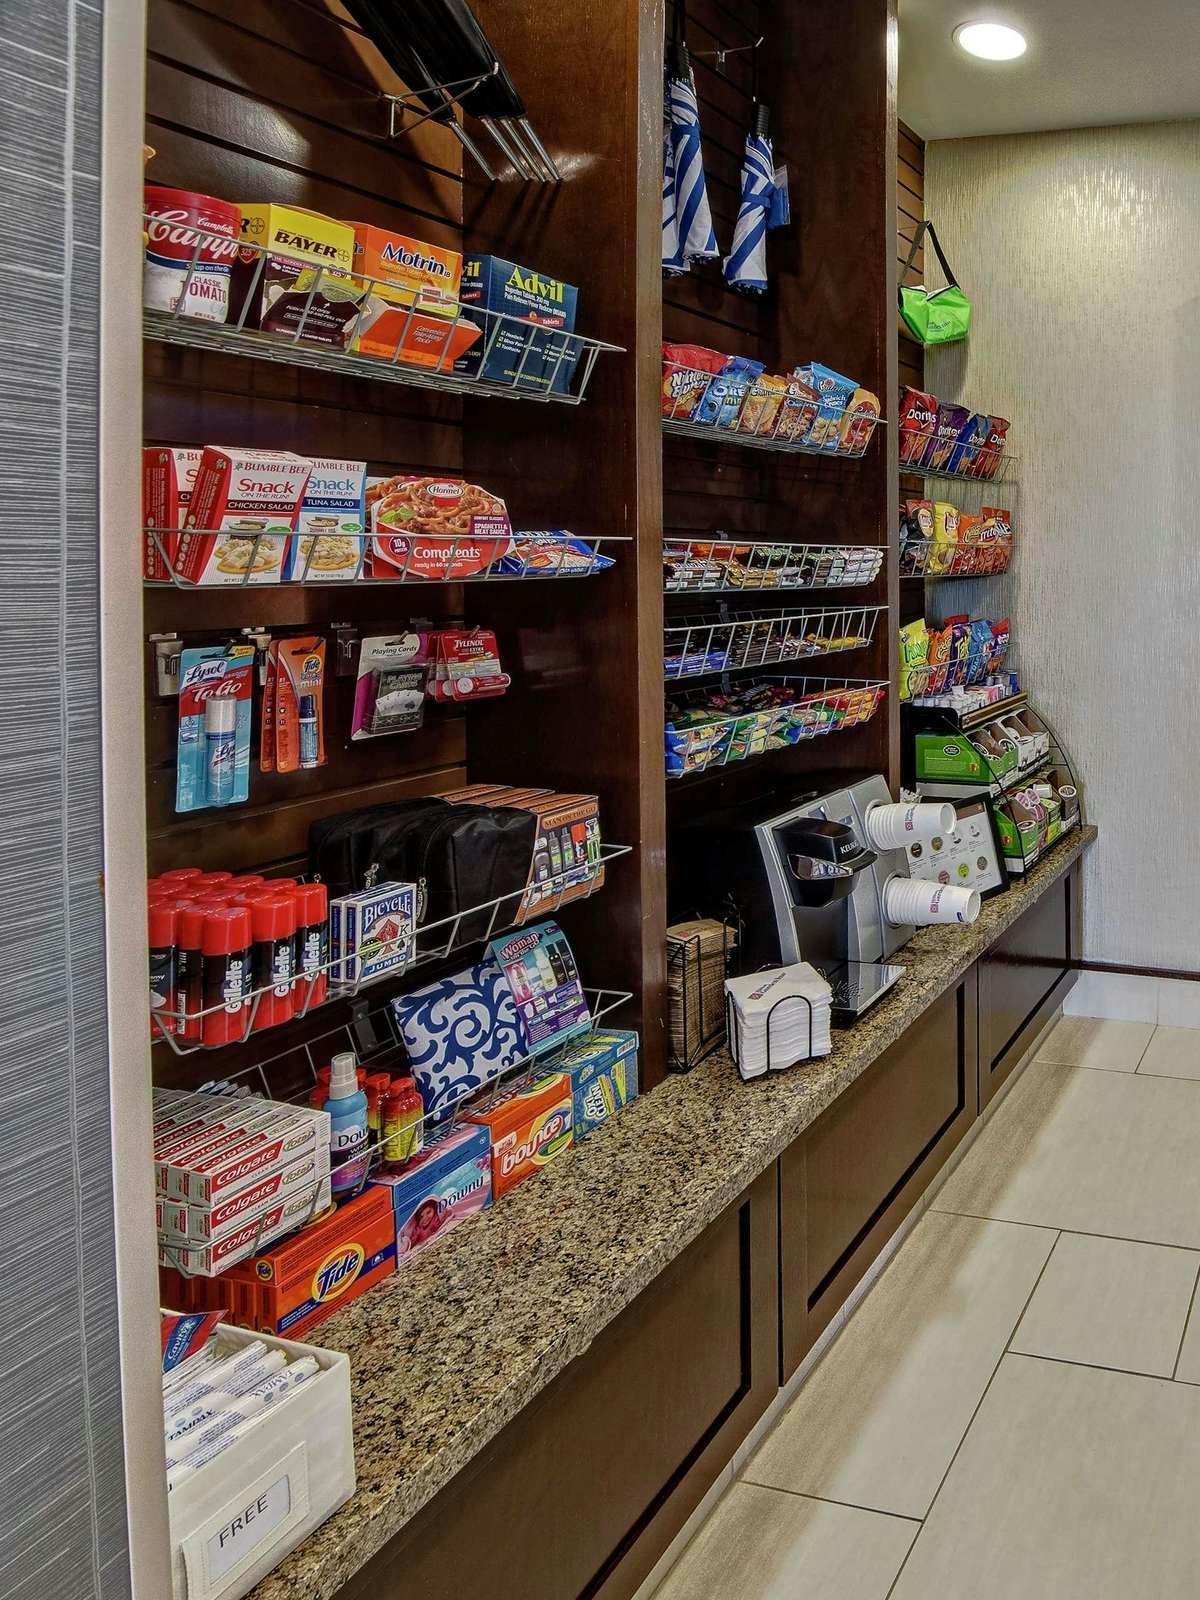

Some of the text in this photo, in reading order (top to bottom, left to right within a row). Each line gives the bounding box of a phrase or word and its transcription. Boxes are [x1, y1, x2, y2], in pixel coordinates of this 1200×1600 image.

[274, 231, 338, 259] BAYER
[381, 241, 446, 277] Motrin
[505, 266, 565, 303] Advil
[713, 384, 745, 397] ORE
[906, 408, 937, 424] Doritos
[244, 462, 309, 475] BUMBLE BEE
[312, 460, 363, 473] UMBLE BEE
[238, 478, 296, 495] Snack
[307, 475, 356, 492] Snack
[433, 484, 461, 495] Hormel
[228, 502, 295, 512] CHICKEN SALAD
[307, 499, 354, 508] TUNA SALAD
[371, 647, 398, 656] Playing
[453, 639, 485, 649] TYLENOL
[186, 662, 226, 683] Lysol
[303, 660, 321, 673] Tide
[217, 680, 242, 698] Go
[544, 817, 562, 828] MAN
[365, 893, 412, 932] BICYCLE
[302, 932, 322, 983] Gillette
[500, 932, 539, 960] Woman
[273, 945, 291, 998] Gillette
[369, 952, 407, 973] JUMBO
[223, 960, 244, 1015] Gillette
[586, 1094, 598, 1118] OXI
[592, 1081, 608, 1118] CLEAN
[159, 1125, 221, 1159] Colgate
[181, 1130, 241, 1165] Colgate
[201, 1135, 263, 1171] Colgate
[501, 1115, 563, 1178] bounce
[216, 1147, 278, 1187] Colgate
[216, 1181, 277, 1221] Colgate
[438, 1175, 485, 1214] Downy
[217, 1212, 278, 1255] Colgate
[317, 1252, 361, 1300] Tide
[252, 1369, 294, 1401] TAMPAX
[167, 1408, 216, 1441] TAMPAX
[218, 1491, 270, 1549] FREE
